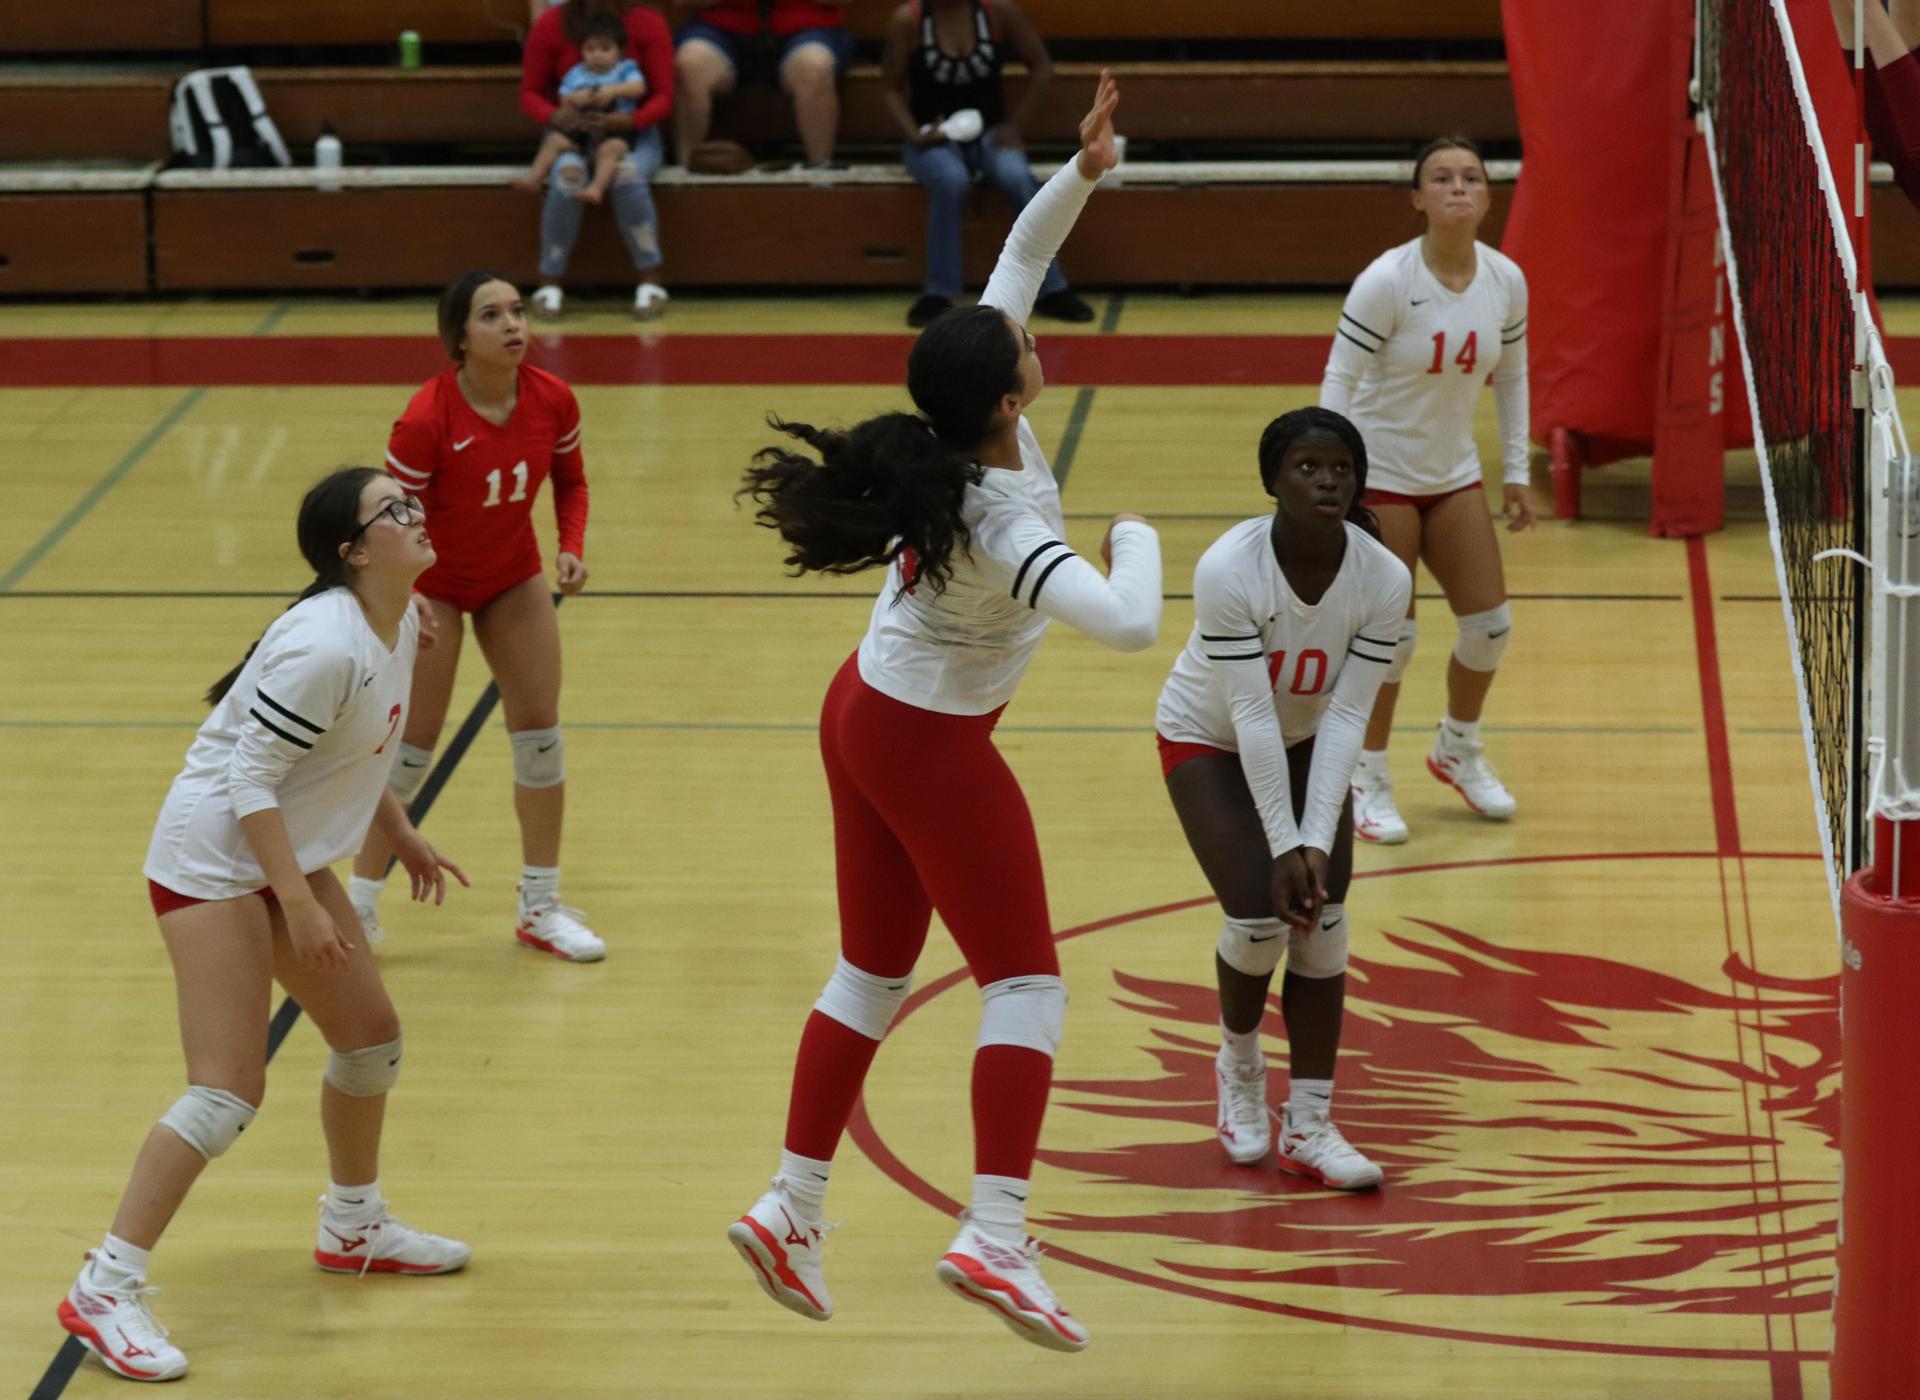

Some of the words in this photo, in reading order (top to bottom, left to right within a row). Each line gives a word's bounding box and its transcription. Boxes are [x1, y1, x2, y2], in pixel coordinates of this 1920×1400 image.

[1427, 331, 1477, 374] 14
[483, 461, 528, 507] 11
[1268, 649, 1328, 695] 10
[373, 703, 401, 755] 7
